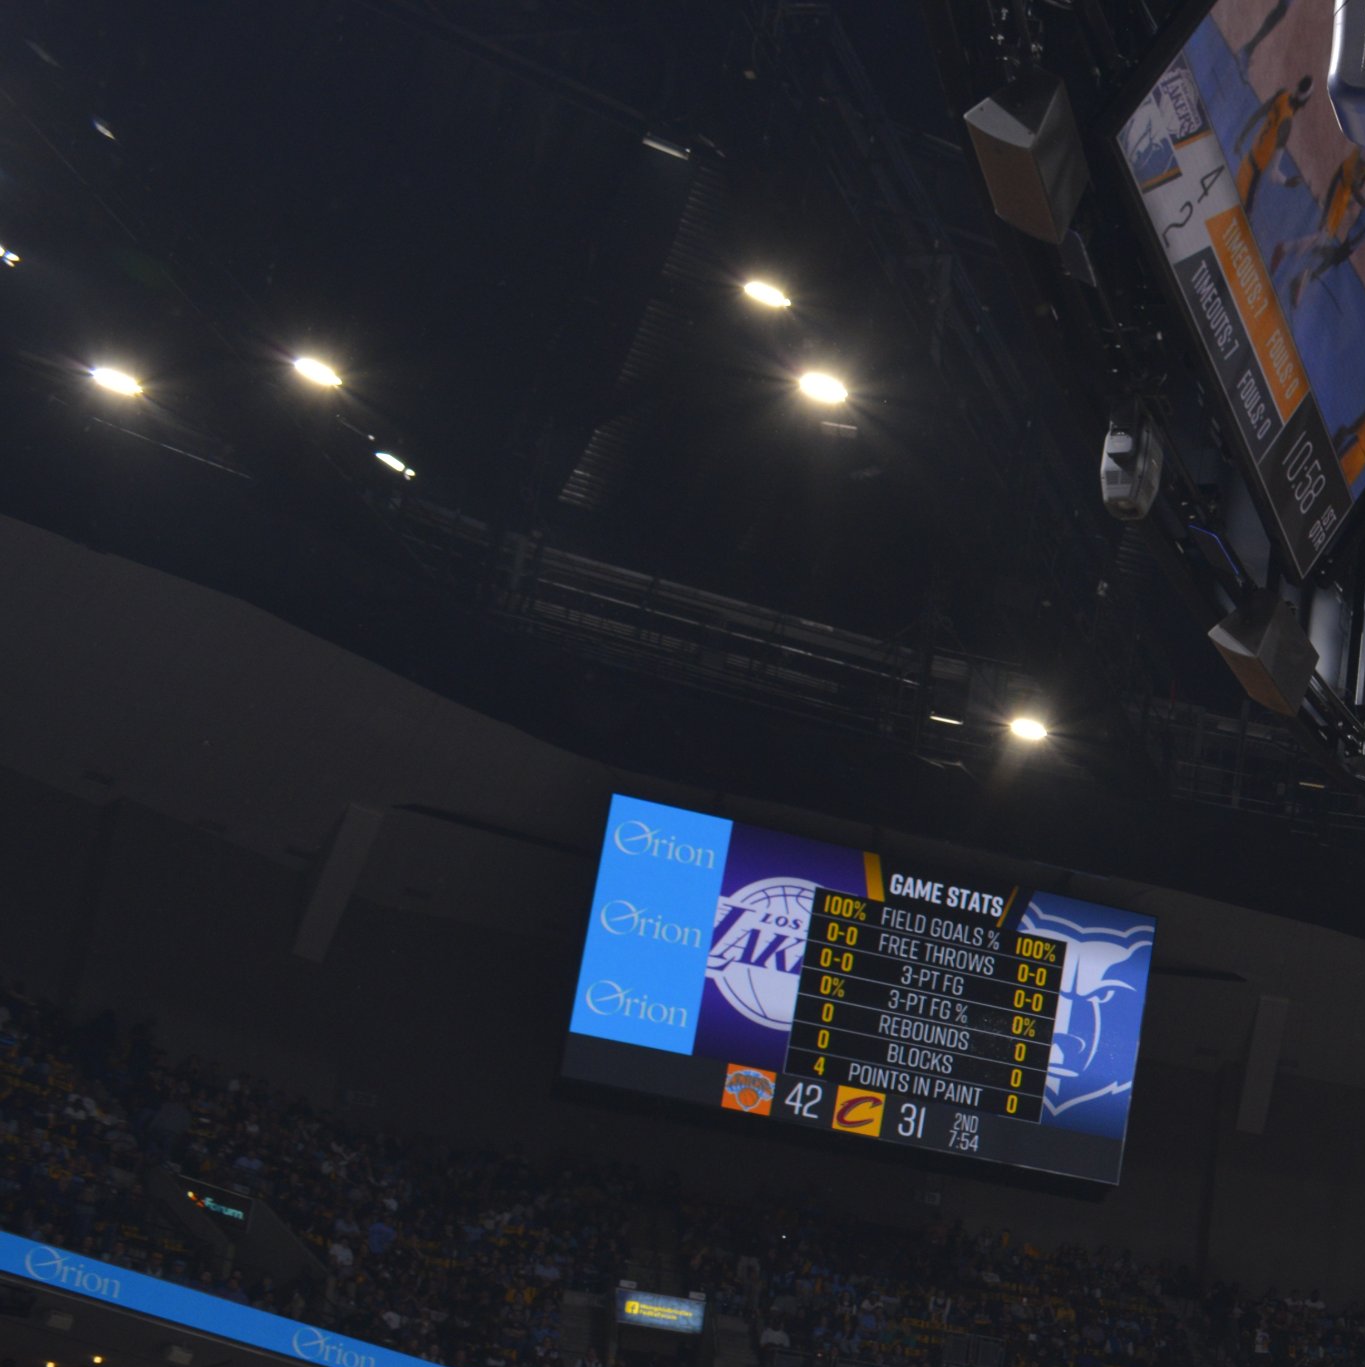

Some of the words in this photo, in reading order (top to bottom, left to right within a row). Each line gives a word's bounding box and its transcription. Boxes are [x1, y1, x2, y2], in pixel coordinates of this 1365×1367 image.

[1197, 165, 1225, 203] 4
[1162, 201, 1194, 248] 2
[1282, 431, 1327, 514] 10:58
[613, 819, 716, 870] Orion
[761, 912, 803, 930] LOS
[890, 873, 944, 904] GAME
[949, 886, 1004, 918] STATS
[600, 900, 702, 949] Orion
[824, 895, 866, 921] 100%
[881, 907, 926, 933] FIELD
[930, 918, 984, 947] GOALS
[987, 931, 1000, 950] %
[1016, 937, 1056, 962] 100%
[820, 949, 854, 972] 0-0
[901, 965, 939, 989] 3-PT
[943, 975, 965, 996] FG
[1014, 989, 1043, 1012] 0-0
[827, 923, 858, 946] 0-0
[879, 933, 920, 959] FREE
[924, 943, 995, 976] THROWS
[1017, 964, 1047, 987] 0-0
[585, 979, 688, 1029] Orion
[820, 975, 845, 998] 0%
[888, 989, 926, 1015] 3-PT
[930, 998, 951, 1020] FG
[955, 1004, 968, 1024] %
[1012, 1015, 1035, 1038] 0%
[818, 1029, 829, 1049] 0
[887, 1044, 953, 1074] BLOCKS
[1010, 1069, 1022, 1088] 0
[822, 1003, 834, 1023] 0
[878, 1014, 970, 1050] REBOUNDS
[1014, 1043, 1026, 1061] 0
[785, 1081, 822, 1119] 42
[897, 1103, 926, 1139] 31
[814, 1056, 825, 1076] 4
[848, 1063, 909, 1093] POINTS
[912, 1077, 930, 1097] IN
[933, 1081, 983, 1107] PAINT
[1006, 1095, 1018, 1114] 0
[948, 1129, 979, 1152] 7:54
[953, 1113, 979, 1133] 2ND
[25, 1245, 121, 1299] Orion
